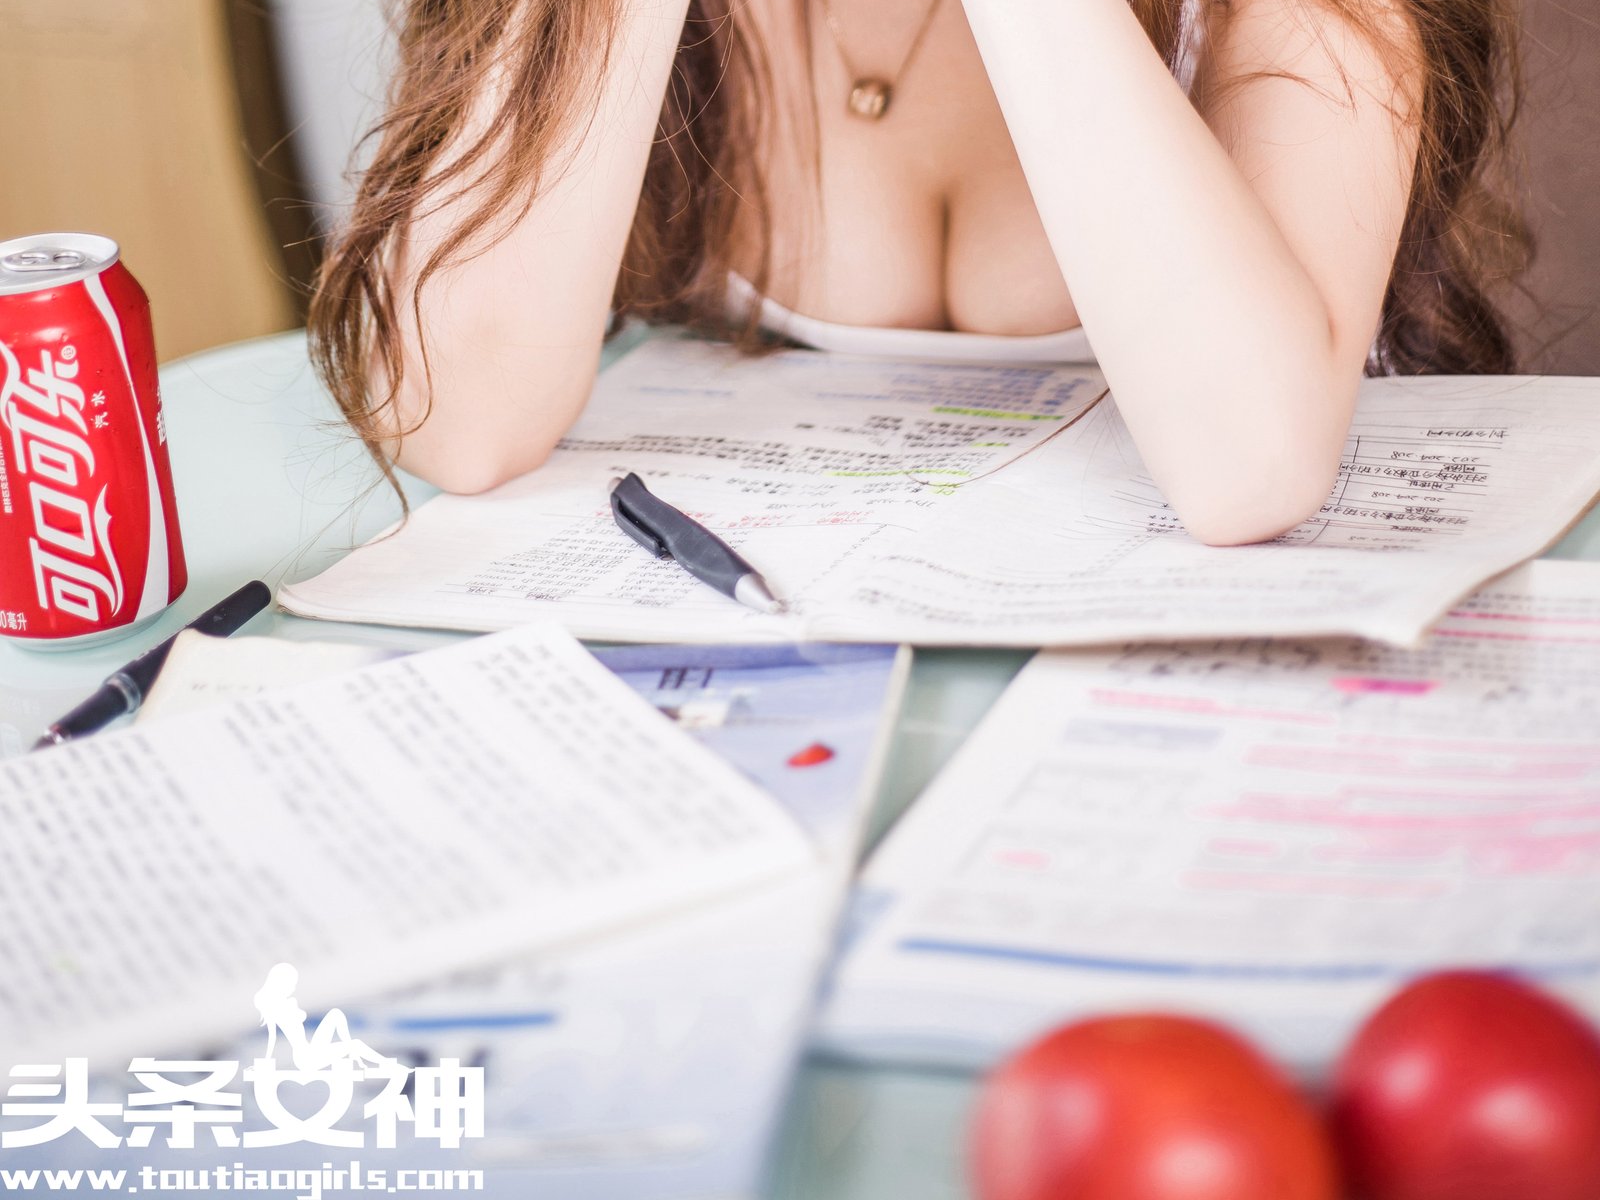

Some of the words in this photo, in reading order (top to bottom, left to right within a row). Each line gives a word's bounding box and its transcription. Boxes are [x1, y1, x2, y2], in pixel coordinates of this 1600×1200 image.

[90, 389, 110, 429] 汽水
[12, 349, 123, 623] 可口可乐
[0, 610, 27, 631] 0毫升
